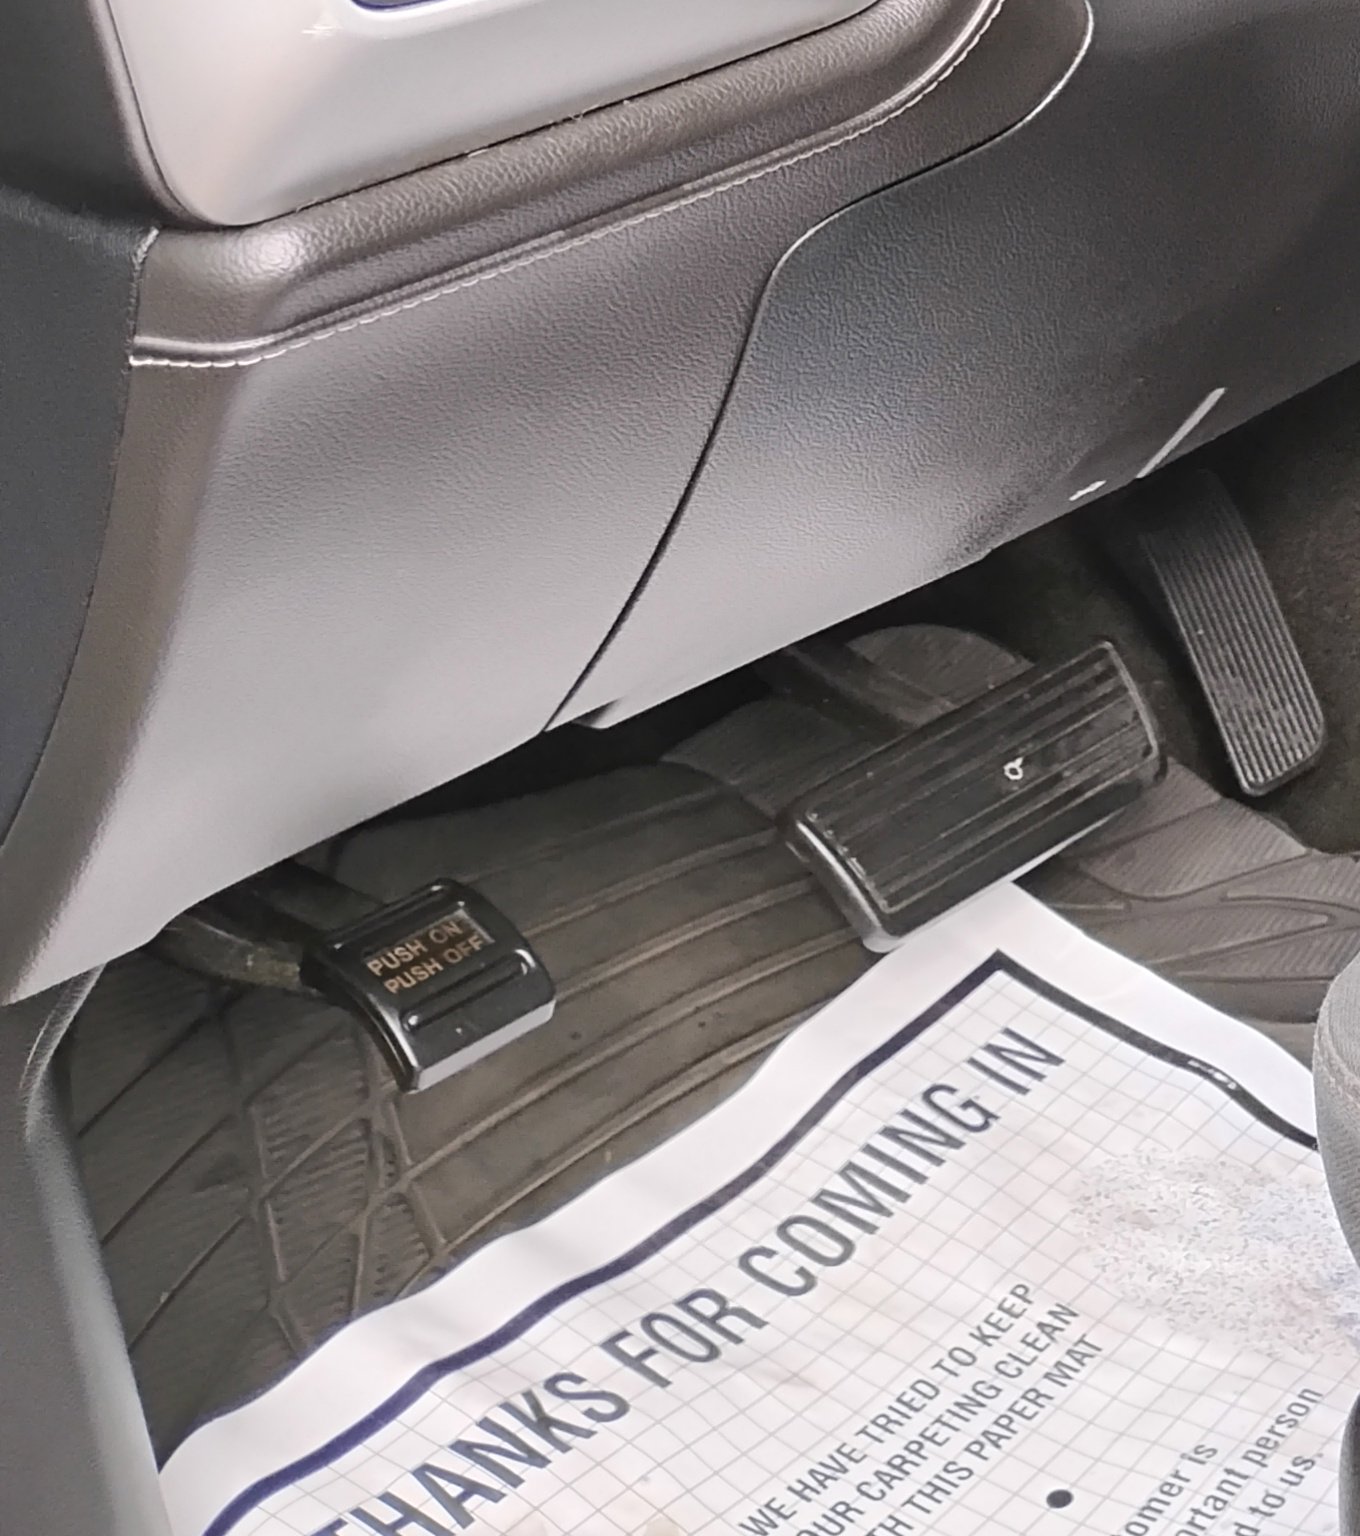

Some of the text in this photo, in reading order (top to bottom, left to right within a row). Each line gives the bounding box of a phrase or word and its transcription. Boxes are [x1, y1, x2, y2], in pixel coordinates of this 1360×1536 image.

[367, 921, 463, 976] PUSH ON
[383, 934, 483, 994] PUSH OFF
[599, 1287, 771, 1389] FOR
[737, 1083, 1000, 1297] COMING
[963, 1026, 1066, 1096] IN
[738, 1283, 1034, 1536] WE HAVE TRIED TO KEEP
[856, 1380, 1003, 1502] CARPETING
[994, 1302, 1079, 1381] CLEAN
[901, 1333, 1103, 1515] THIS PAPER MAT
[1241, 1388, 1324, 1468] person
[1180, 1443, 1218, 1465] is
[1247, 1489, 1287, 1518] to
